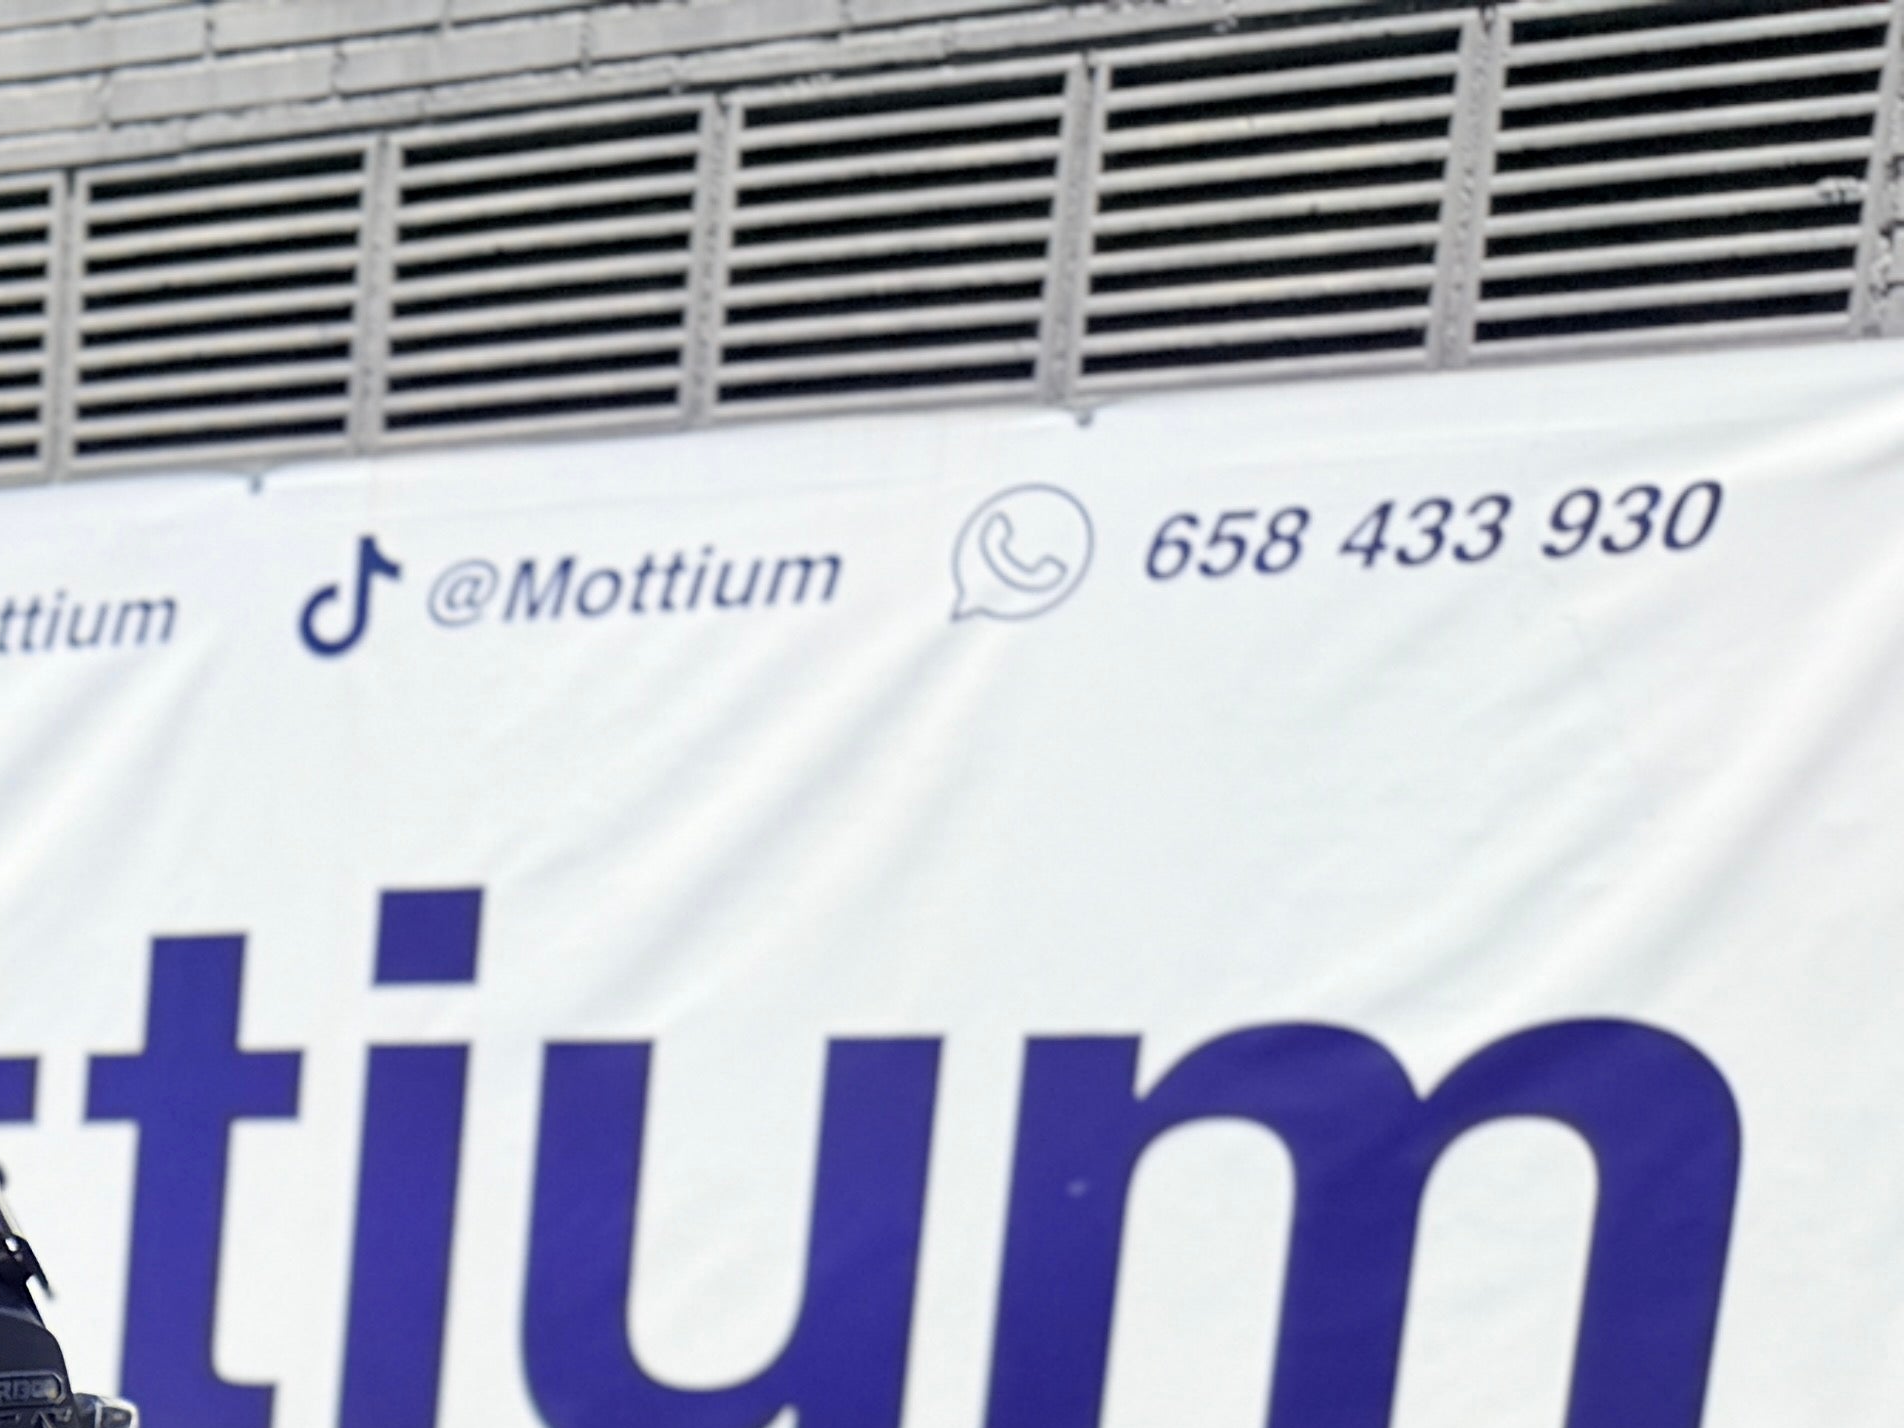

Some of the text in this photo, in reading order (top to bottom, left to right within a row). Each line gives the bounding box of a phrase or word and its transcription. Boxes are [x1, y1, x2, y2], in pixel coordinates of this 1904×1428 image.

[1143, 478, 1726, 583] 658 433 930
[427, 544, 844, 627] @Mottium
